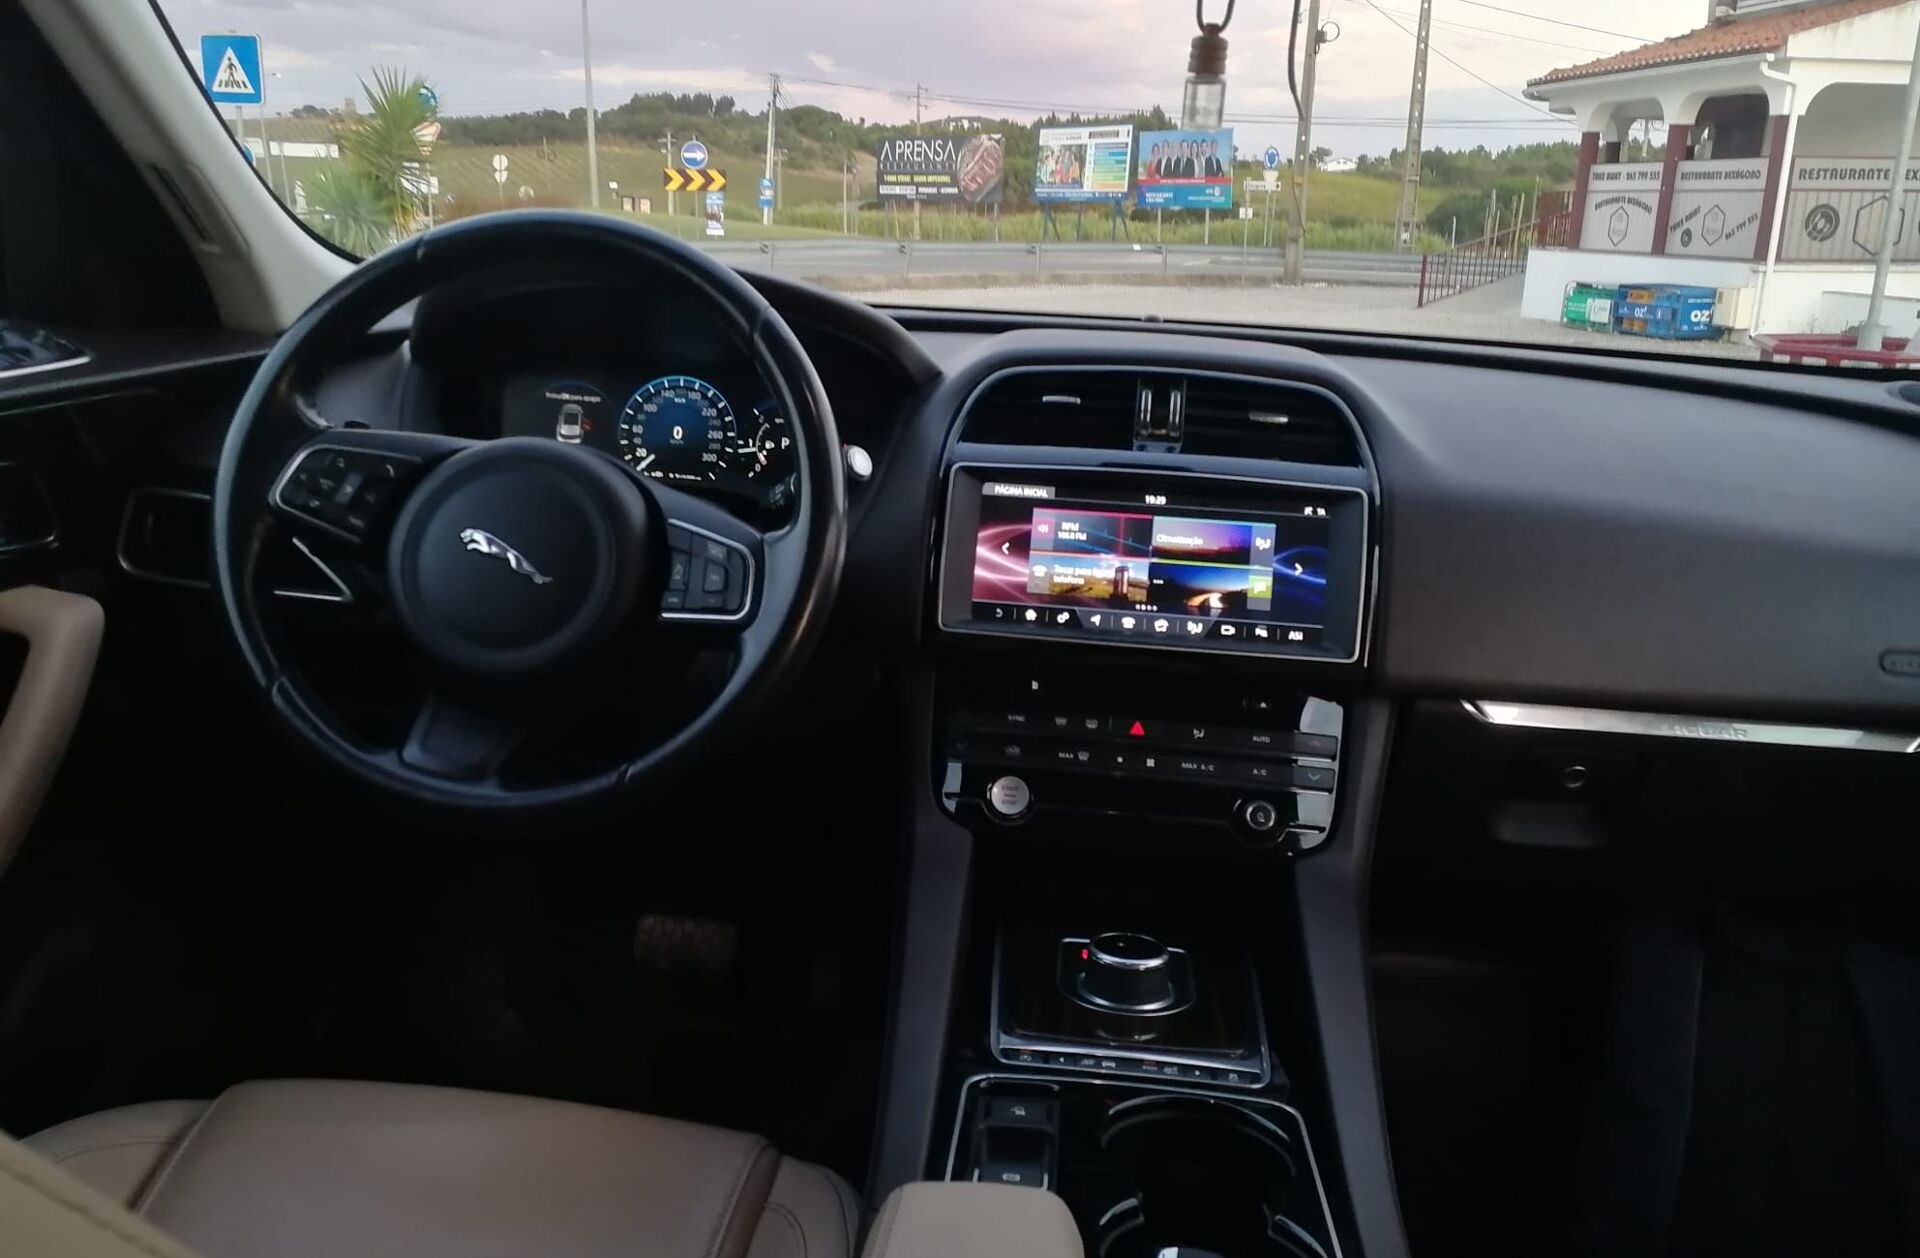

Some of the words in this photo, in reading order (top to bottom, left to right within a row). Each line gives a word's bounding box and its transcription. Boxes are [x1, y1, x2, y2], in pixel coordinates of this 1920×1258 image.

[896, 140, 956, 161] PRENSA
[1681, 170, 1722, 180] RESTAURANTE
[1799, 168, 1891, 181] RESTAURANTE
[643, 403, 657, 412] 100
[701, 407, 717, 417] 220
[672, 425, 683, 440] 0
[707, 430, 723, 440] 260
[781, 437, 790, 450] P
[701, 452, 717, 462] 300
[995, 485, 1023, 497] PÁGINA
[1252, 735, 1271, 743] AUTO
